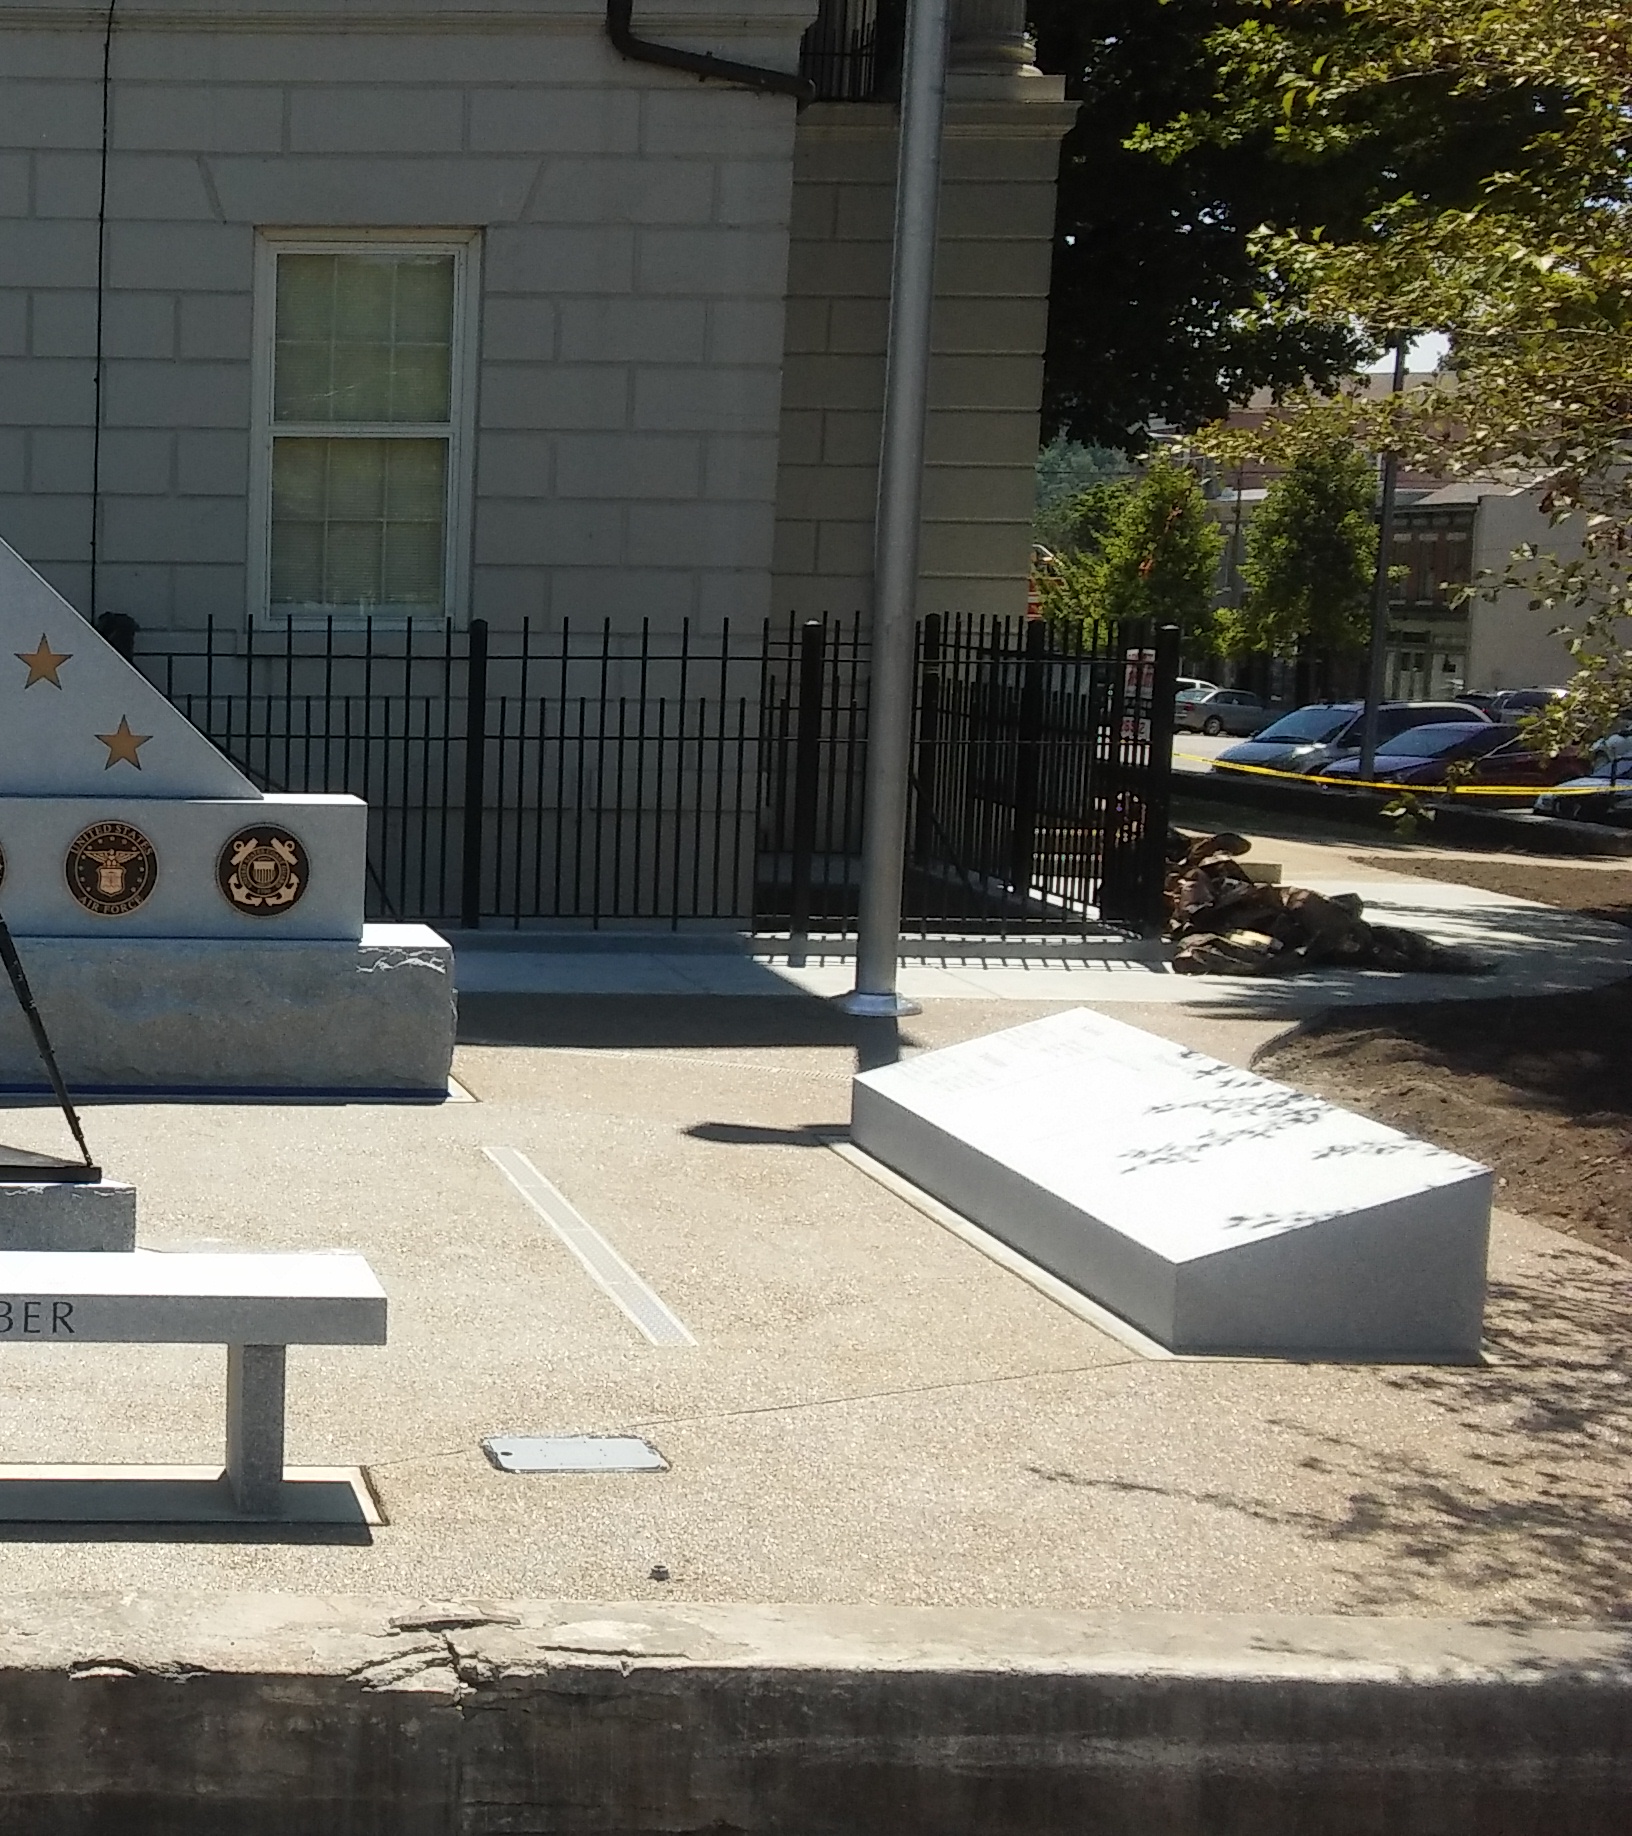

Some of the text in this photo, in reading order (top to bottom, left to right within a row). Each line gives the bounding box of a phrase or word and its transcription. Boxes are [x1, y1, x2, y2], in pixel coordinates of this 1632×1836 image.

[70, 824, 153, 855] UNITED STATES
[78, 894, 145, 914] AIR FORCE
